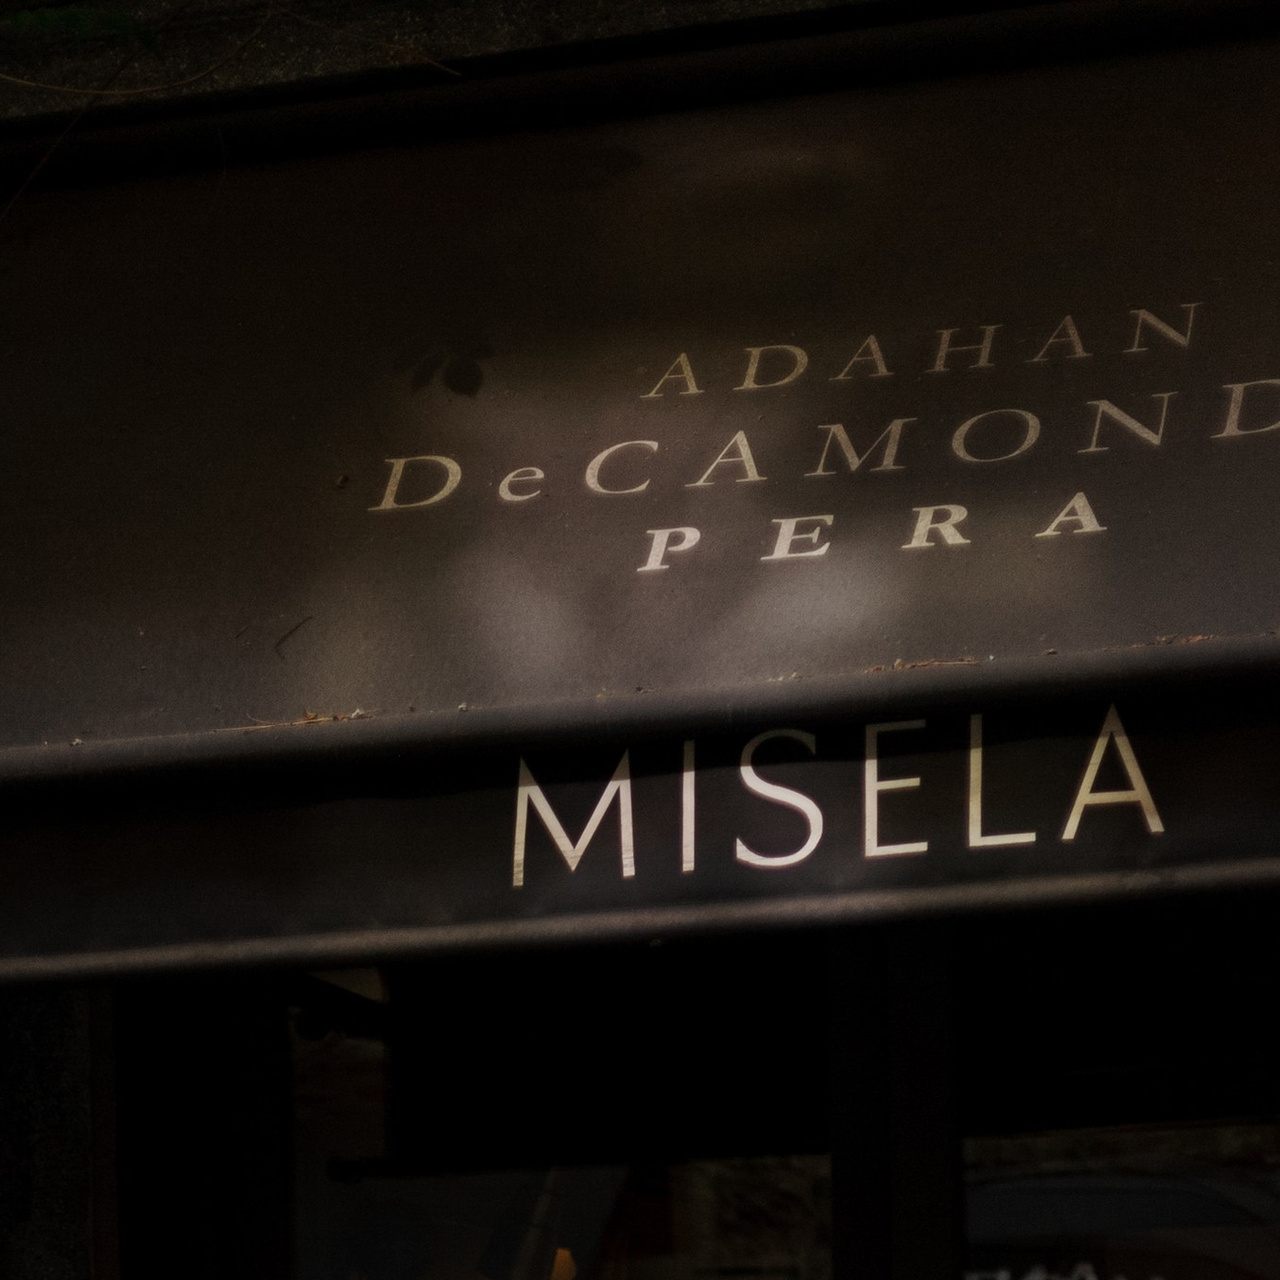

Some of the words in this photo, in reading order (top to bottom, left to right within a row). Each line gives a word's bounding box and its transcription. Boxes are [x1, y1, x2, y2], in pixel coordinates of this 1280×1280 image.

[639, 303, 1202, 398] ADAHAN
[637, 492, 1108, 572] PERA
[512, 704, 1166, 887] MISELA
